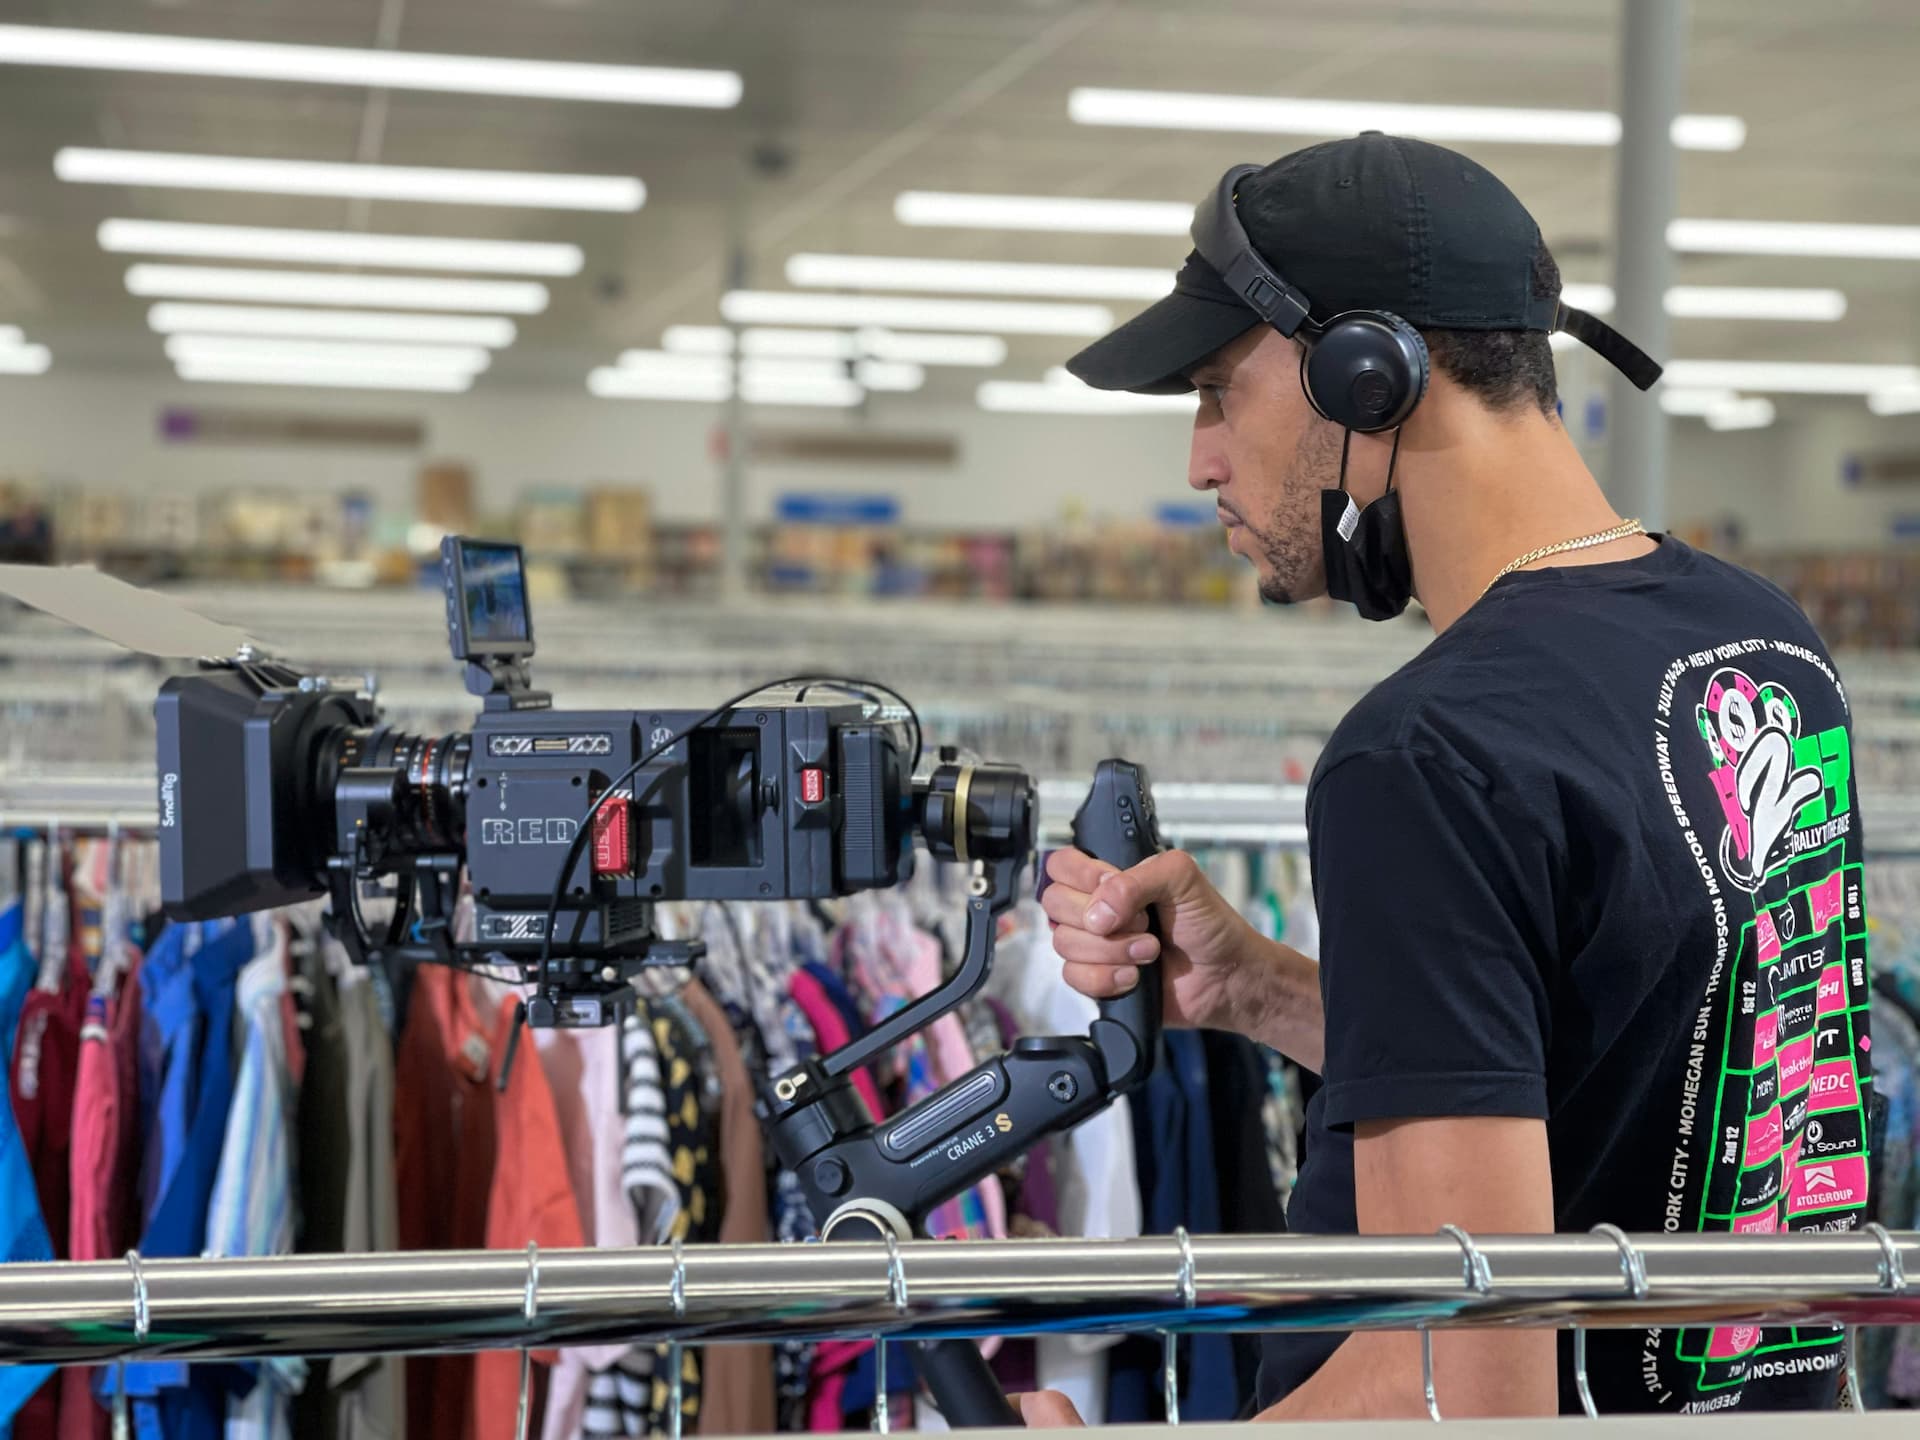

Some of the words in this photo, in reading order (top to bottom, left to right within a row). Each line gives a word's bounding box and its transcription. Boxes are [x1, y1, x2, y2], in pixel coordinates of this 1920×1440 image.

[1688, 649, 1715, 668] NEW
[1713, 642, 1745, 661] YORK
[1741, 638, 1768, 653] CITY
[1774, 640, 1836, 685] MOHEGAN
[1657, 680, 1674, 717] JULY
[1655, 731, 1690, 827] SPEEDWAY
[482, 818, 577, 844] RED
[1684, 830, 1720, 895] MOTOR
[1705, 897, 1728, 996] THOMPSON
[1741, 995, 1755, 1015] 1st
[1743, 980, 1757, 994] 12
[1693, 1005, 1712, 1041] SUN
[1678, 1044, 1705, 1135] MOHEGAN
[1811, 1072, 1850, 1093] NEDC
[947, 1133, 986, 1161] CRANE
[985, 1125, 996, 1138] 3
[1726, 1126, 1740, 1140] 12
[1817, 1138, 1857, 1152] Sound
[1670, 1147, 1689, 1189] CITY
[1664, 1192, 1683, 1233] ORK
[1796, 1189, 1854, 1207] ATOZGROUP
[1643, 1350, 1662, 1392] JULY
